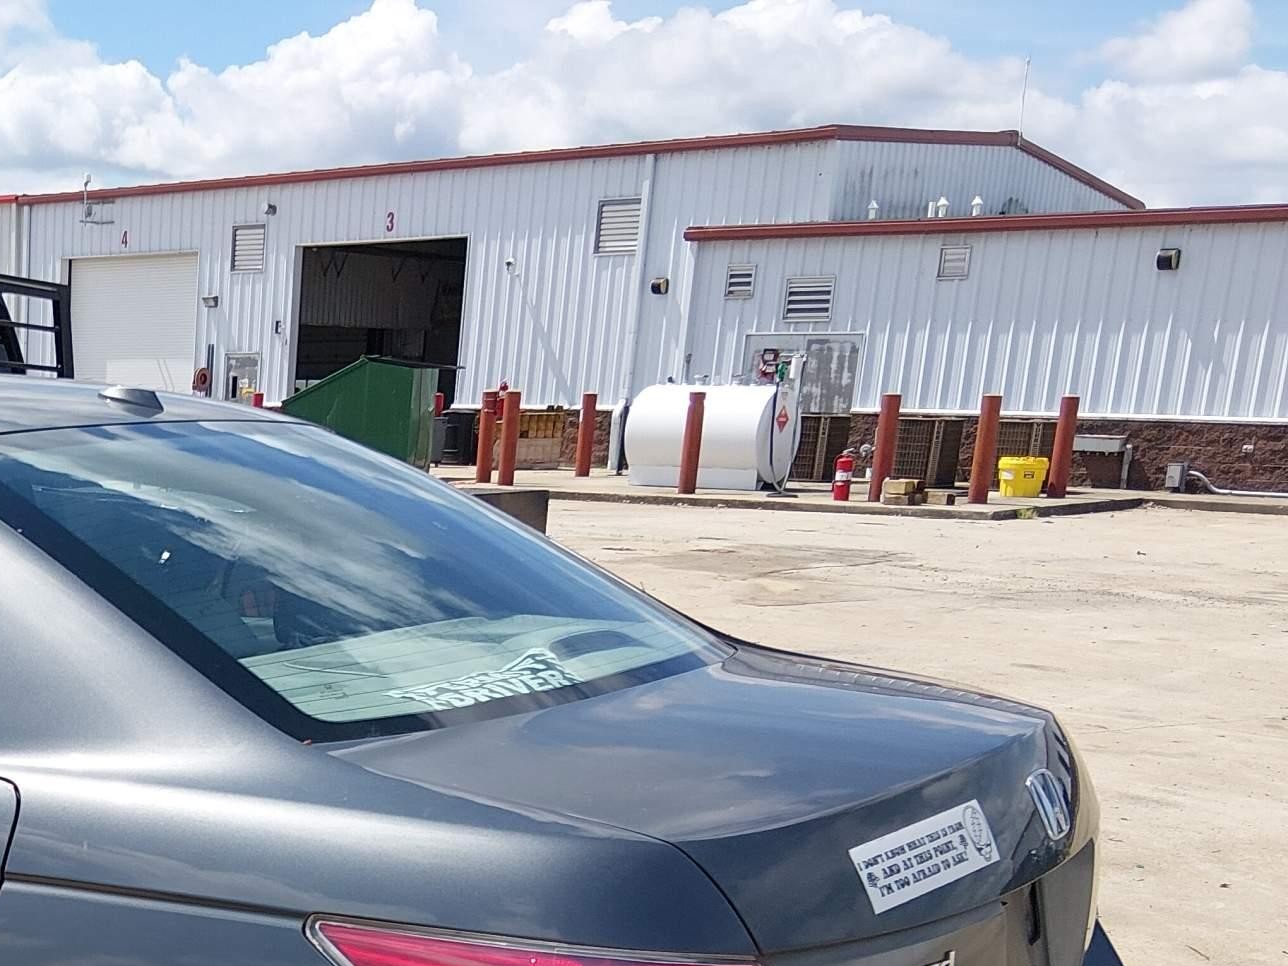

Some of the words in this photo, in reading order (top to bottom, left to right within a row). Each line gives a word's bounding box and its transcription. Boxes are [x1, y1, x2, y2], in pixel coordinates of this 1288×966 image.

[386, 212, 395, 233] 3
[121, 230, 129, 249] 4
[881, 863, 902, 879] AND
[903, 857, 915, 871] AT
[914, 849, 933, 864] THIS
[895, 876, 911, 891] TOO
[911, 863, 941, 884] AFRAID
[942, 859, 951, 871] TO
